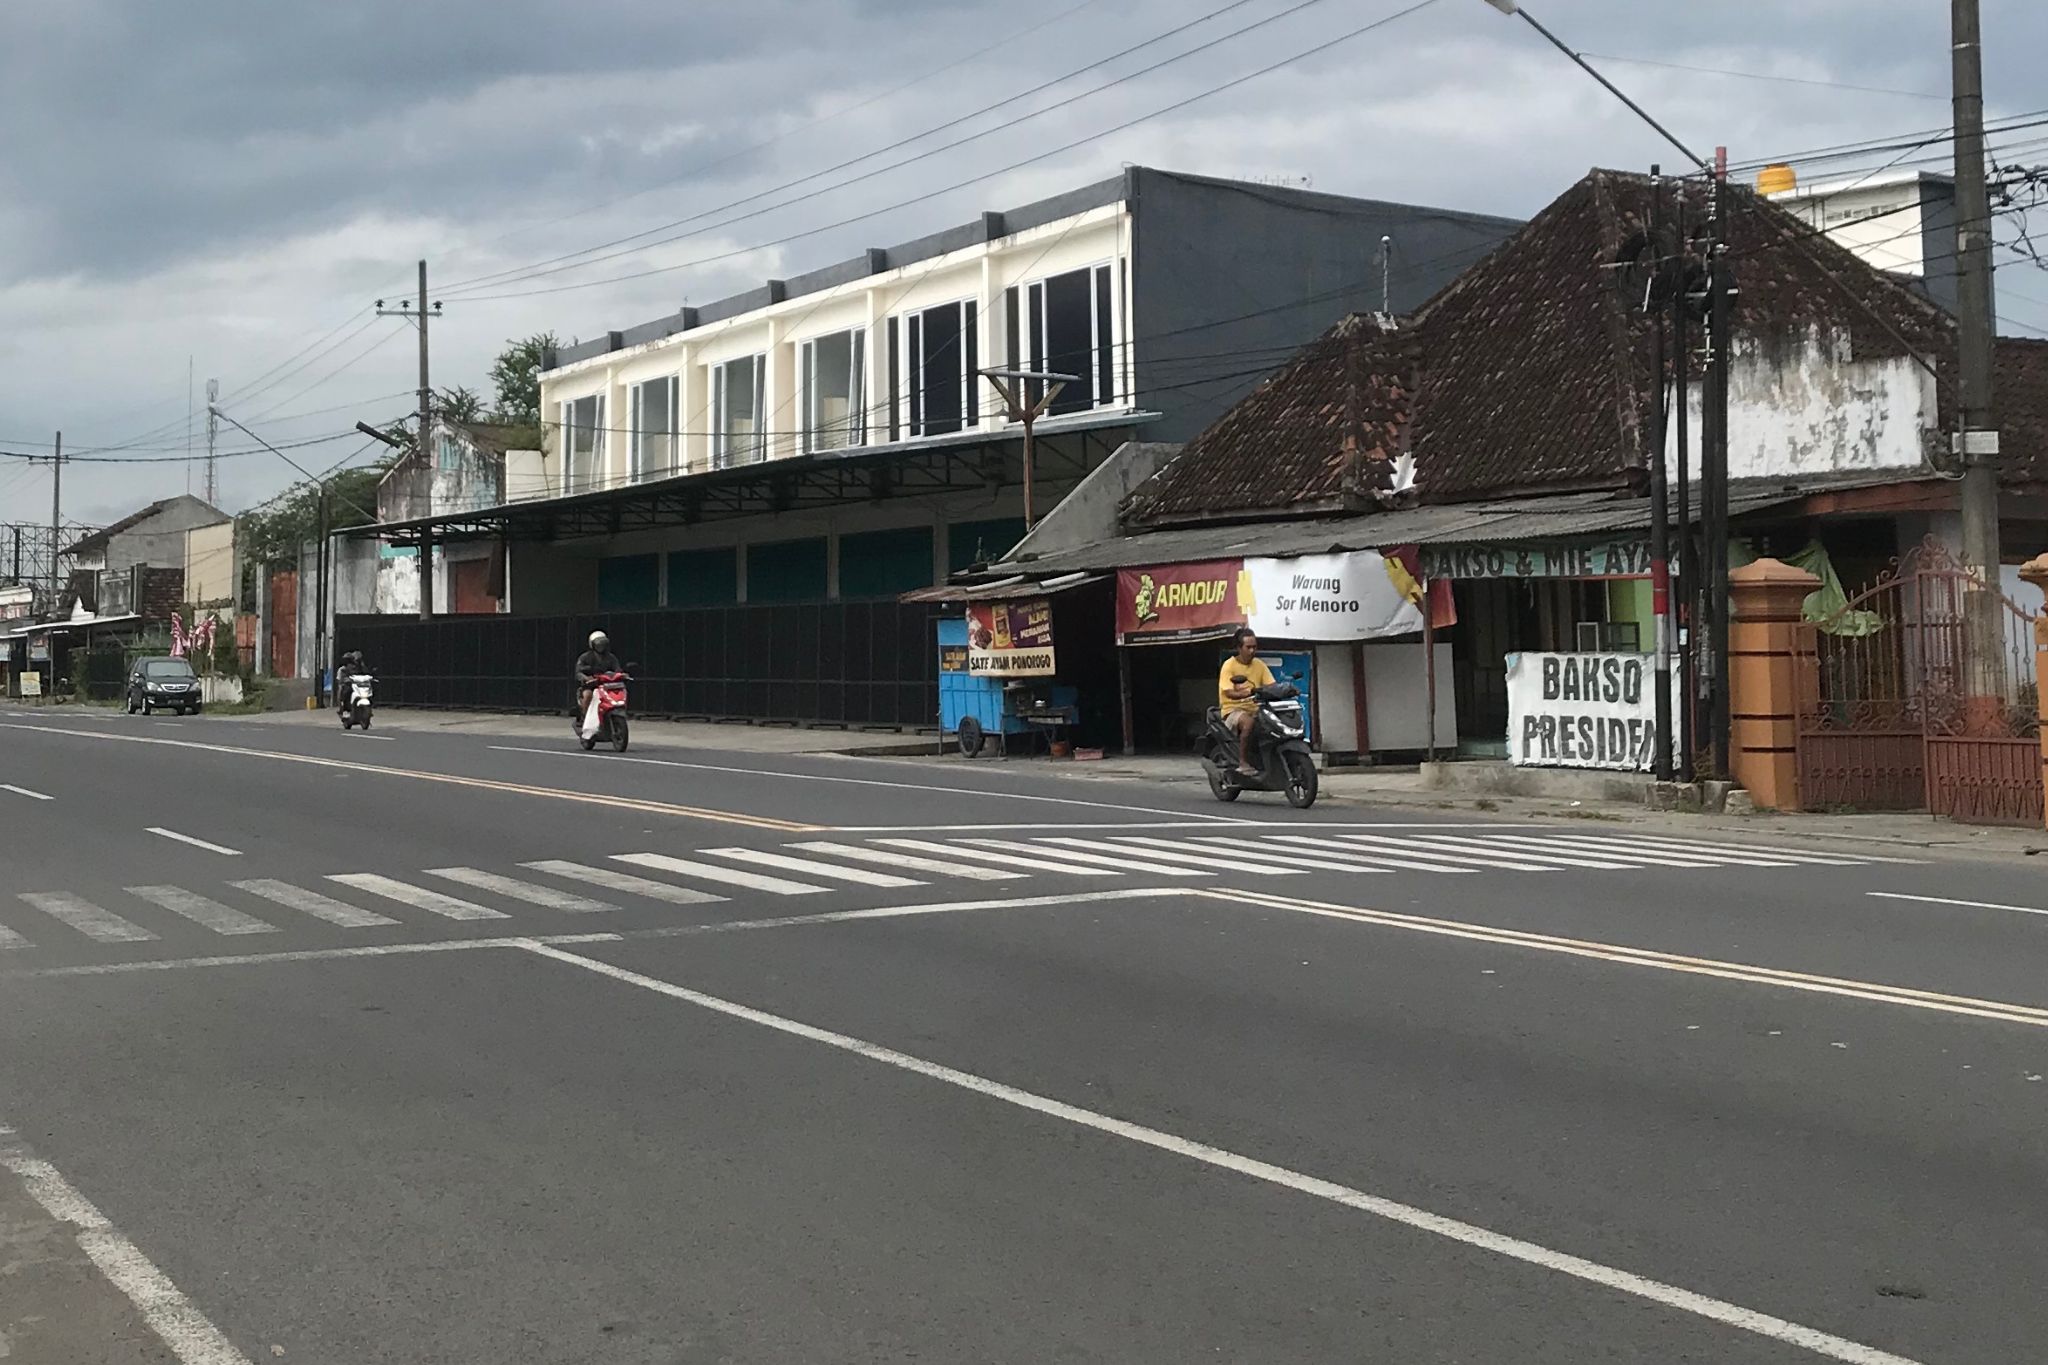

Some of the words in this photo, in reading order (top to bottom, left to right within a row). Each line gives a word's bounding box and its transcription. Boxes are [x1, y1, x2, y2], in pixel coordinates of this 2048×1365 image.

[1516, 549, 1534, 576] &
[1545, 546, 1593, 576] MIE
[1155, 580, 1228, 608] ARMOUR
[1292, 574, 1341, 594] Warung
[1276, 595, 1296, 611] Sor
[1300, 597, 1360, 613] Menoro
[970, 656, 990, 670] SATE
[990, 655, 1010, 670] AYAM
[1543, 657, 1642, 704] BAKSO
